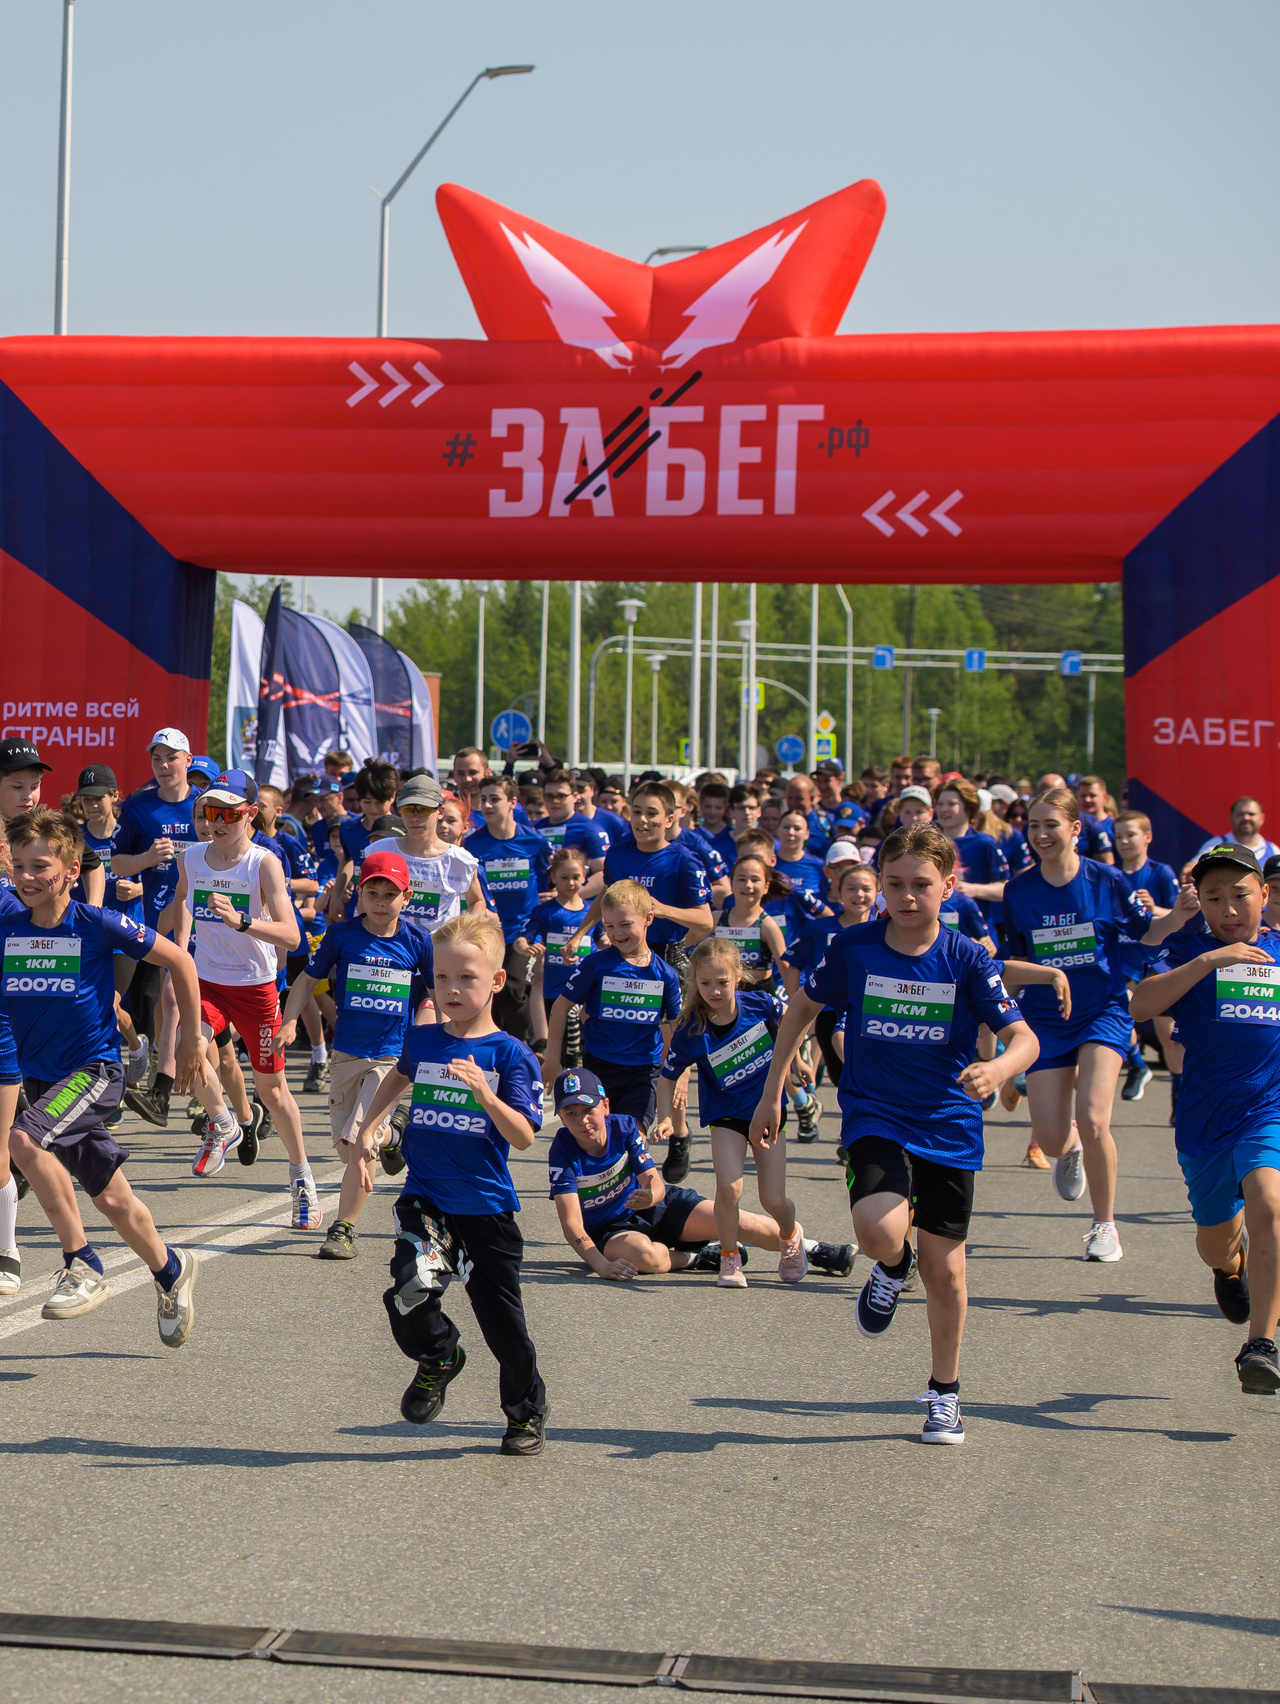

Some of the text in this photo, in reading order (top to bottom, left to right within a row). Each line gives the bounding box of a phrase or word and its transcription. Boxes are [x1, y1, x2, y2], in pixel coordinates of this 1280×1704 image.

[3, 702, 78, 721] ритме
[86, 698, 139, 718] всей
[1153, 716, 1280, 749] ЗАБЕГ
[161, 823, 190, 834] ЗАБЕГ
[213, 880, 231, 888] ЗАБЕГ
[489, 881, 529, 890] 20496
[400, 905, 436, 917] 0444
[1042, 913, 1077, 926] ЗАБЕГ
[1053, 928, 1074, 937] ЗАБЕГ
[29, 939, 55, 950] ЗАБЕГ
[1052, 941, 1078, 951] 1KM
[25, 959, 57, 969] 1KM
[365, 956, 393, 967] ЗАБЕГ
[1041, 953, 1095, 968] 20355
[370, 968, 392, 978] ЗАБЕГ
[1246, 966, 1272, 978] ЗАБЕГ
[6, 977, 76, 992] 20076
[366, 983, 392, 993] 1KM
[624, 980, 645, 989] ЗАБЕГ
[896, 984, 926, 996] ЗАБЕГ
[1242, 986, 1275, 997] 1KM
[350, 996, 403, 1012] 20071
[620, 995, 645, 1004] 1KM
[602, 1007, 658, 1022] 20007
[890, 1003, 928, 1016] 1KM
[1220, 1003, 1280, 1020] 2044
[867, 1020, 945, 1041] 20476
[729, 1034, 750, 1053] ЗАБЕГ
[732, 1046, 756, 1065] 1KM
[723, 1049, 773, 1087] 20352
[432, 1089, 469, 1104] 1KM
[412, 1108, 487, 1134] 20032
[597, 1167, 617, 1181] ЗАБЕГ
[596, 1176, 620, 1192] 1KM
